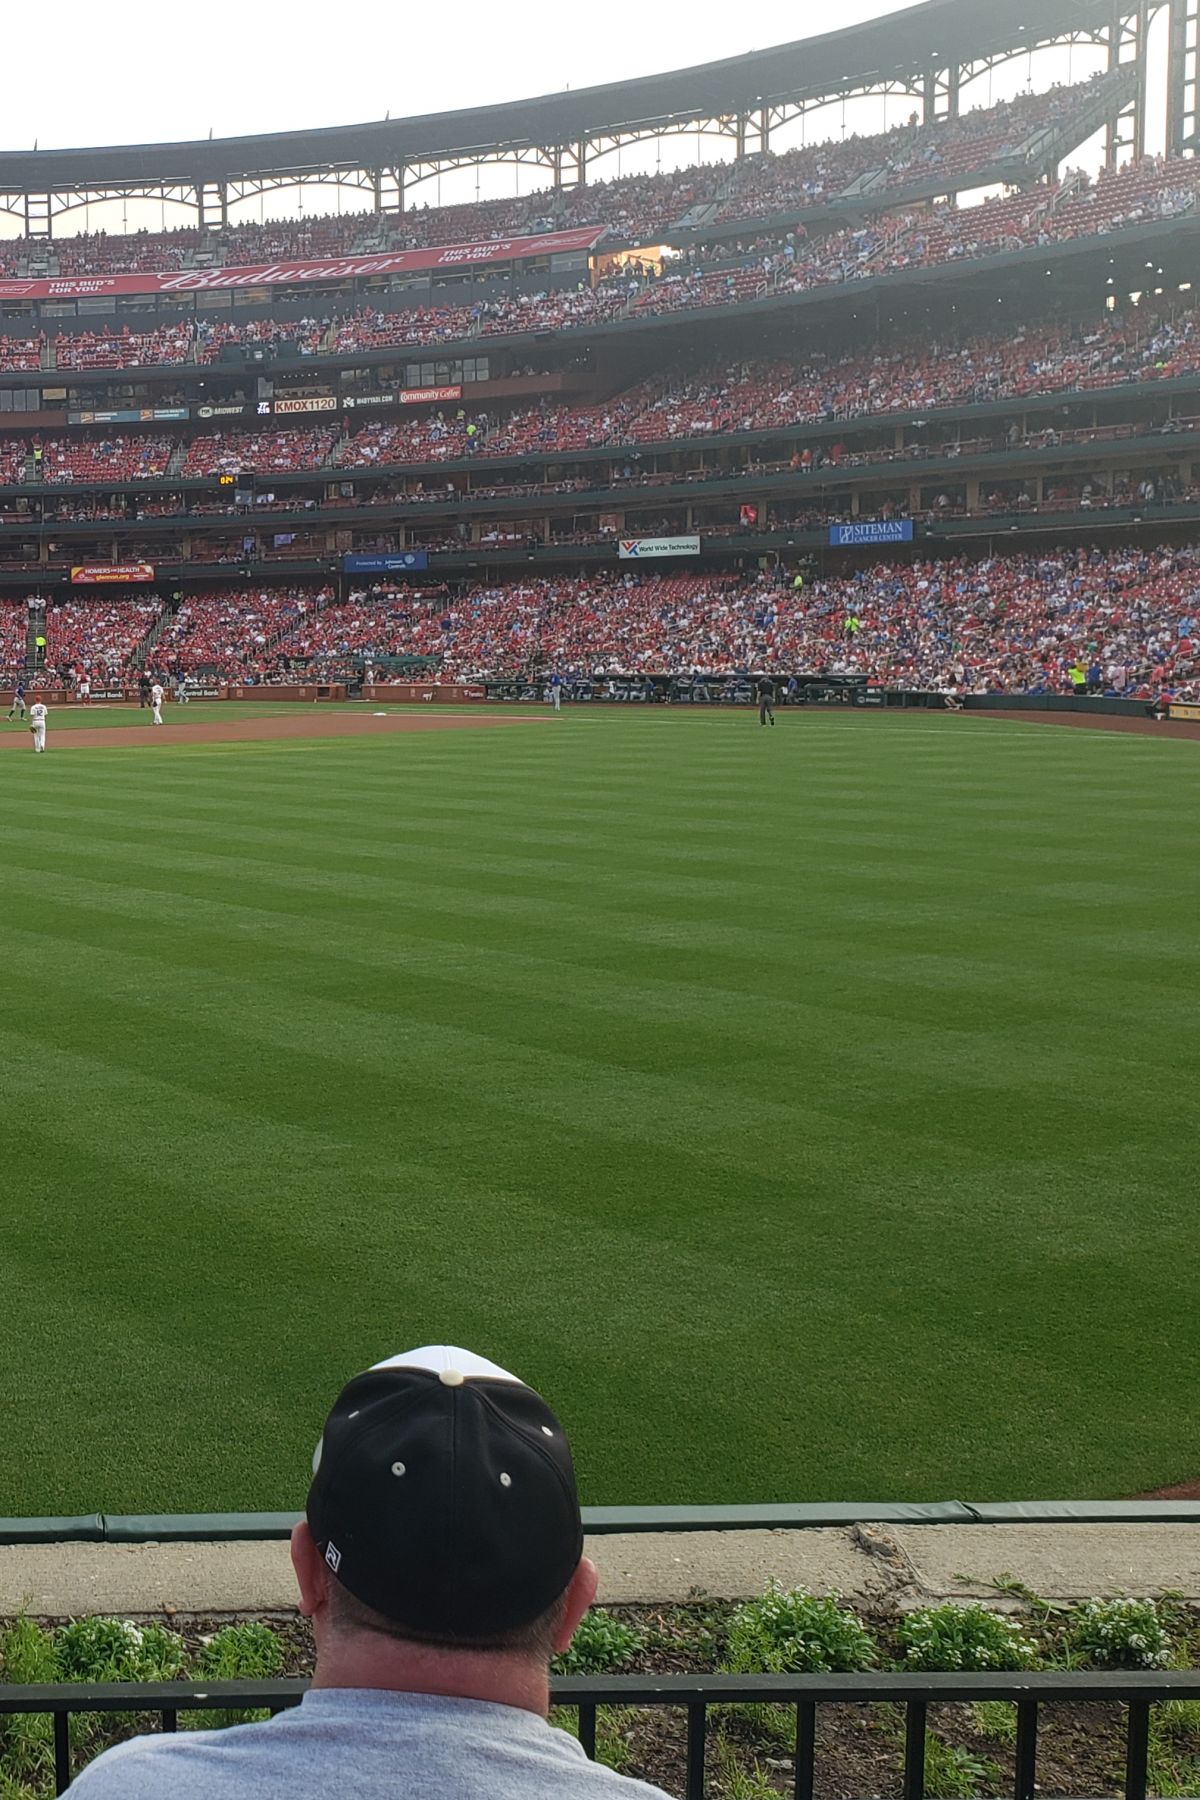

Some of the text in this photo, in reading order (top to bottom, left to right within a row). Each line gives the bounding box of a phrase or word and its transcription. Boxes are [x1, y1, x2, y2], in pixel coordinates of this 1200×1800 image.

[443, 243, 512, 257] THIS BUD'S
[438, 253, 464, 263] FOR
[157, 256, 405, 290] Budweiser
[75, 285, 102, 293] YOU.
[400, 391, 439, 403] Community
[213, 406, 244, 415] MIDWEST
[854, 521, 903, 536] SITEMAN
[854, 532, 903, 543] CANCER CENTER
[668, 543, 698, 551] Technology
[107, 690, 123, 698] Bank
[204, 687, 219, 696] Bank
